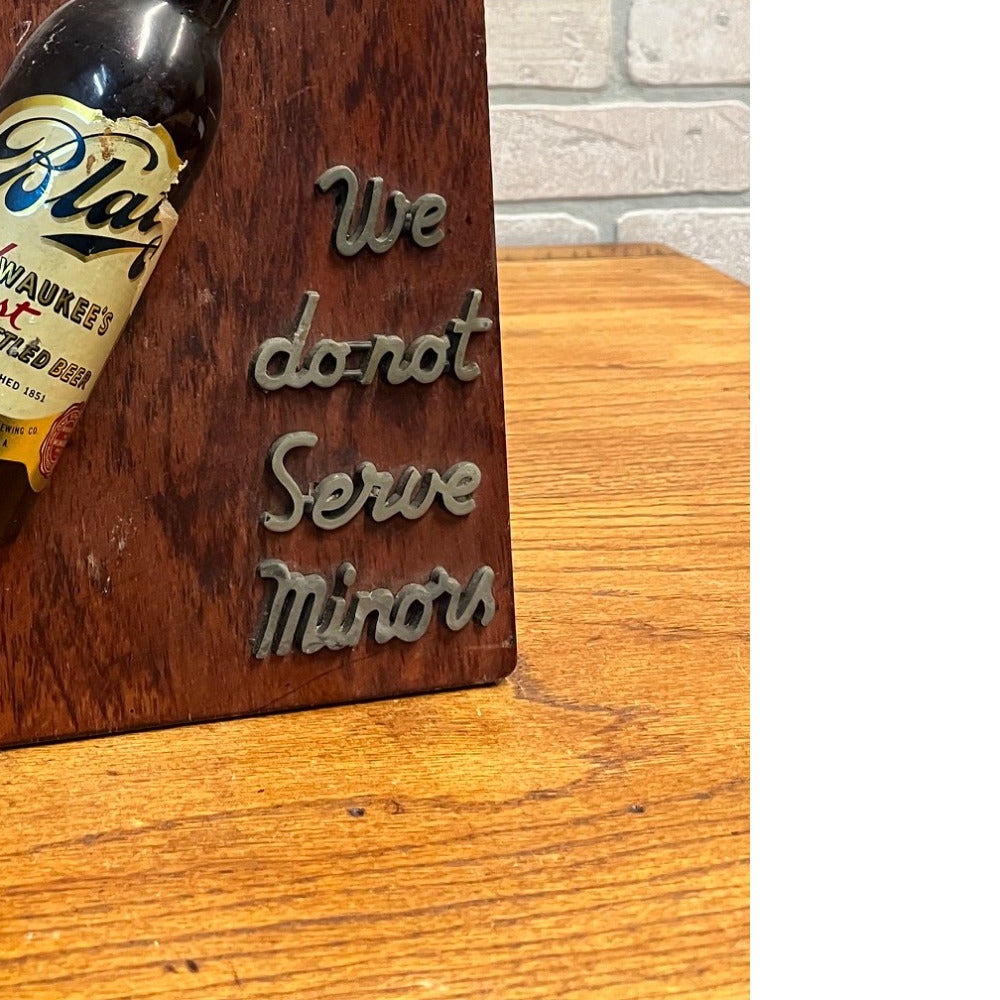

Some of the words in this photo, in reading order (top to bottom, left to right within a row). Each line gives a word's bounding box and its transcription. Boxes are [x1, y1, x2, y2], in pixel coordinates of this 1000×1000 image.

[314, 165, 448, 257] We
[48, 358, 92, 391] BEER
[253, 290, 352, 393] do
[360, 289, 493, 387] not
[23, 386, 47, 403] 1851
[260, 431, 483, 532] Serve
[254, 559, 497, 660] Minors
